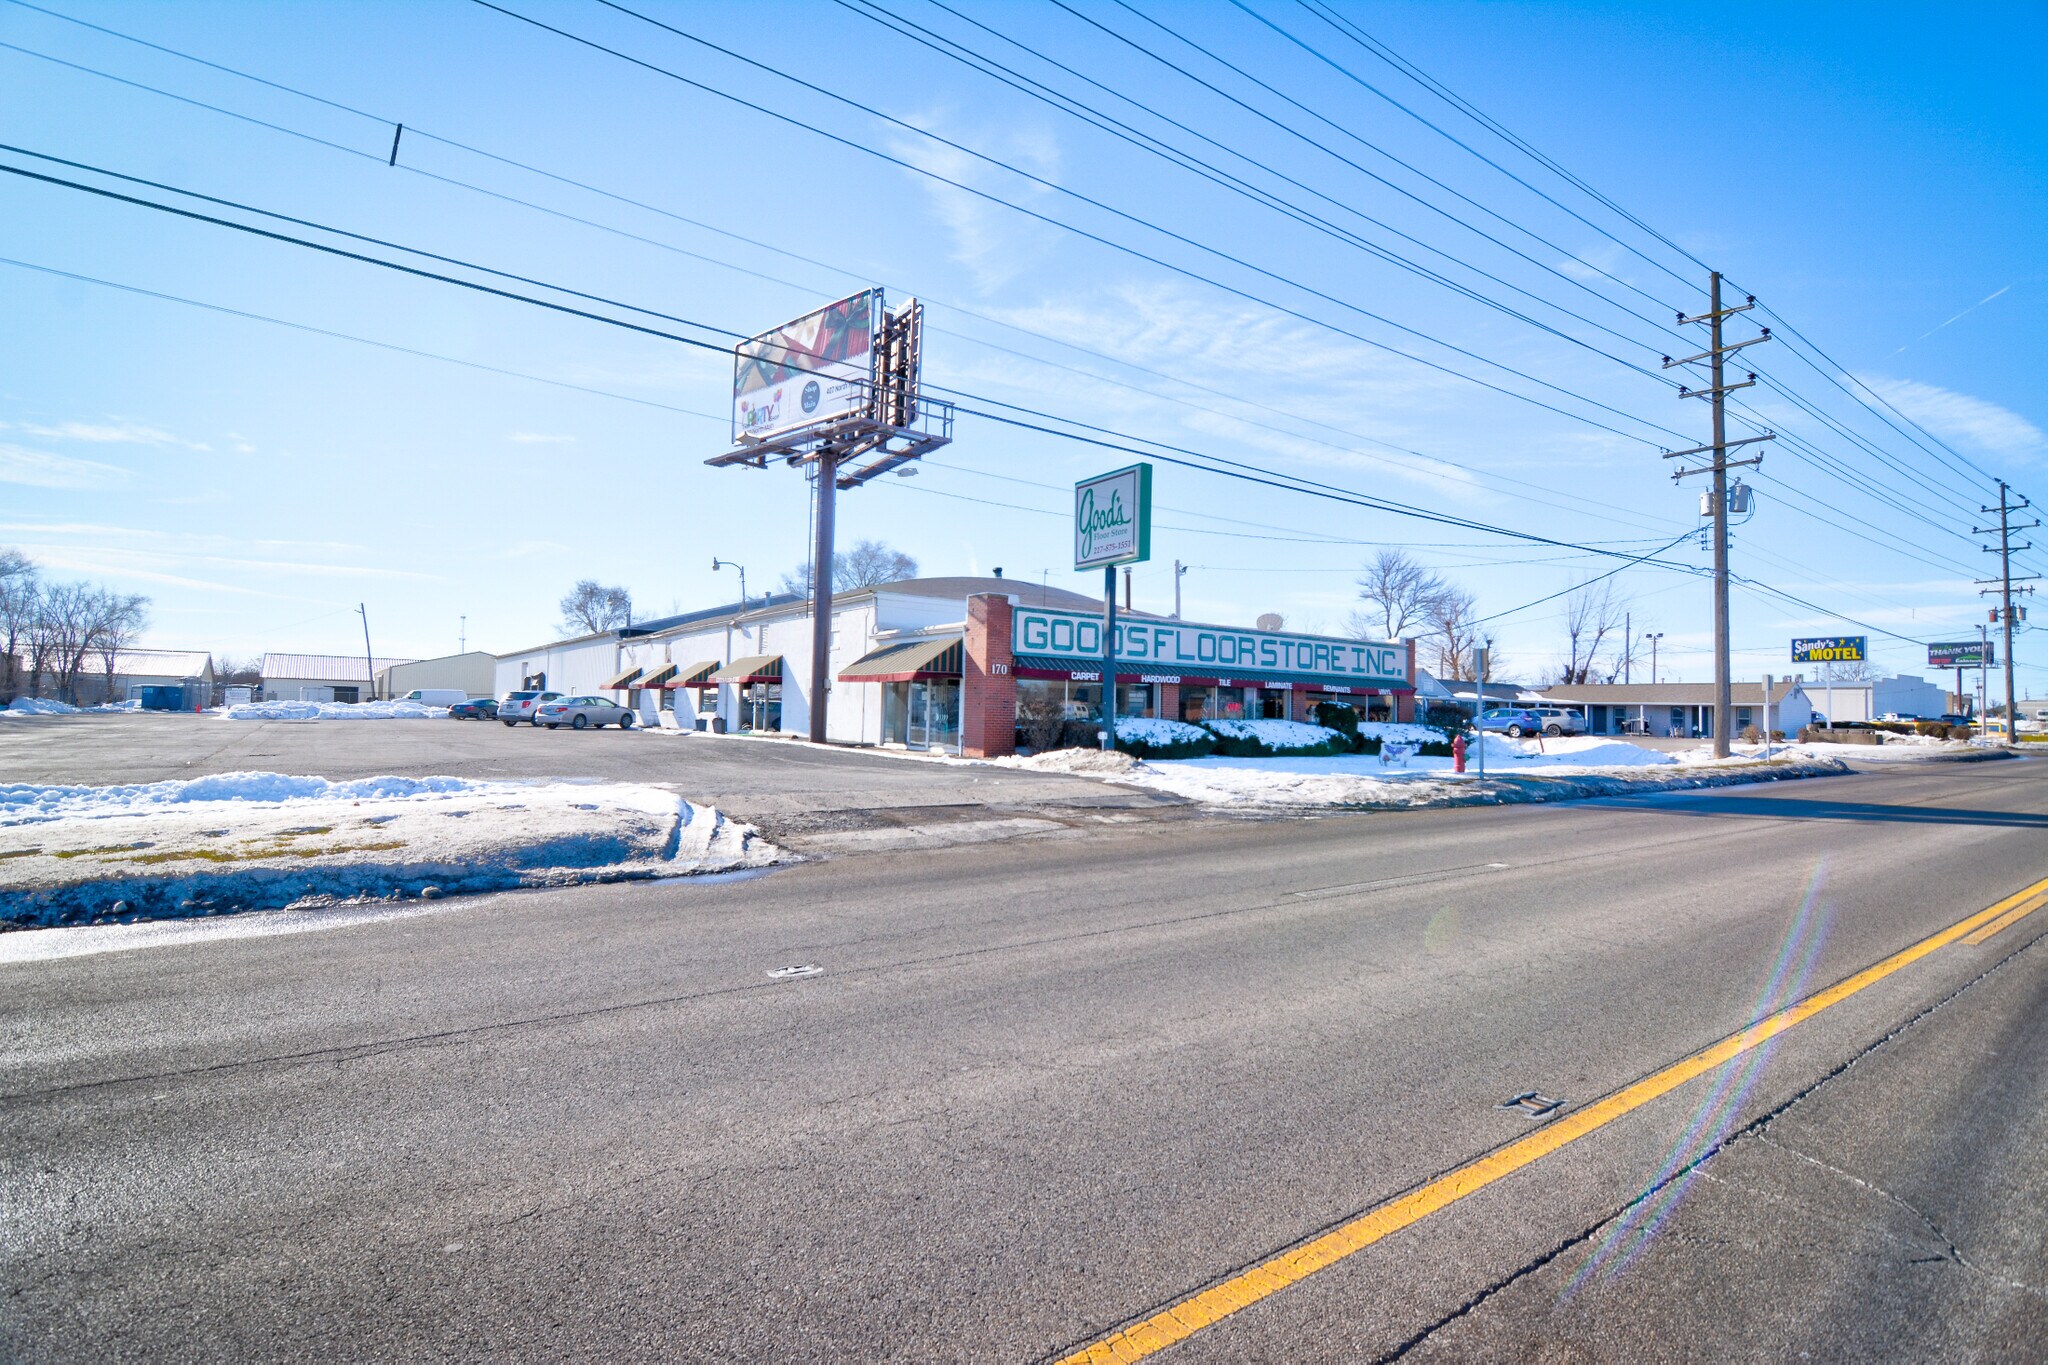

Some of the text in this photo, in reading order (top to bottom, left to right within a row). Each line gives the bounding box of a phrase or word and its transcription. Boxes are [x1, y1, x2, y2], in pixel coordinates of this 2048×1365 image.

[1079, 488, 1132, 559] Good's
[1093, 528, 1128, 541] Floor Store
[1154, 628, 1255, 666] FLOOR
[1261, 639, 1346, 672] STORE
[1351, 647, 1402, 676] INC.
[1794, 639, 1835, 655] Sandy's
[1929, 647, 1962, 656] THANK
[1809, 647, 1861, 661] MOTEL
[991, 663, 1007, 675] 170
[1071, 671, 1100, 681] CARPET
[1141, 675, 1181, 684] HARDWOOD
[1218, 678, 1231, 687] TILE
[1264, 681, 1293, 690] LAMINATE
[1323, 685, 1351, 694] REMNANTS
[1377, 688, 1393, 696] VINYL
